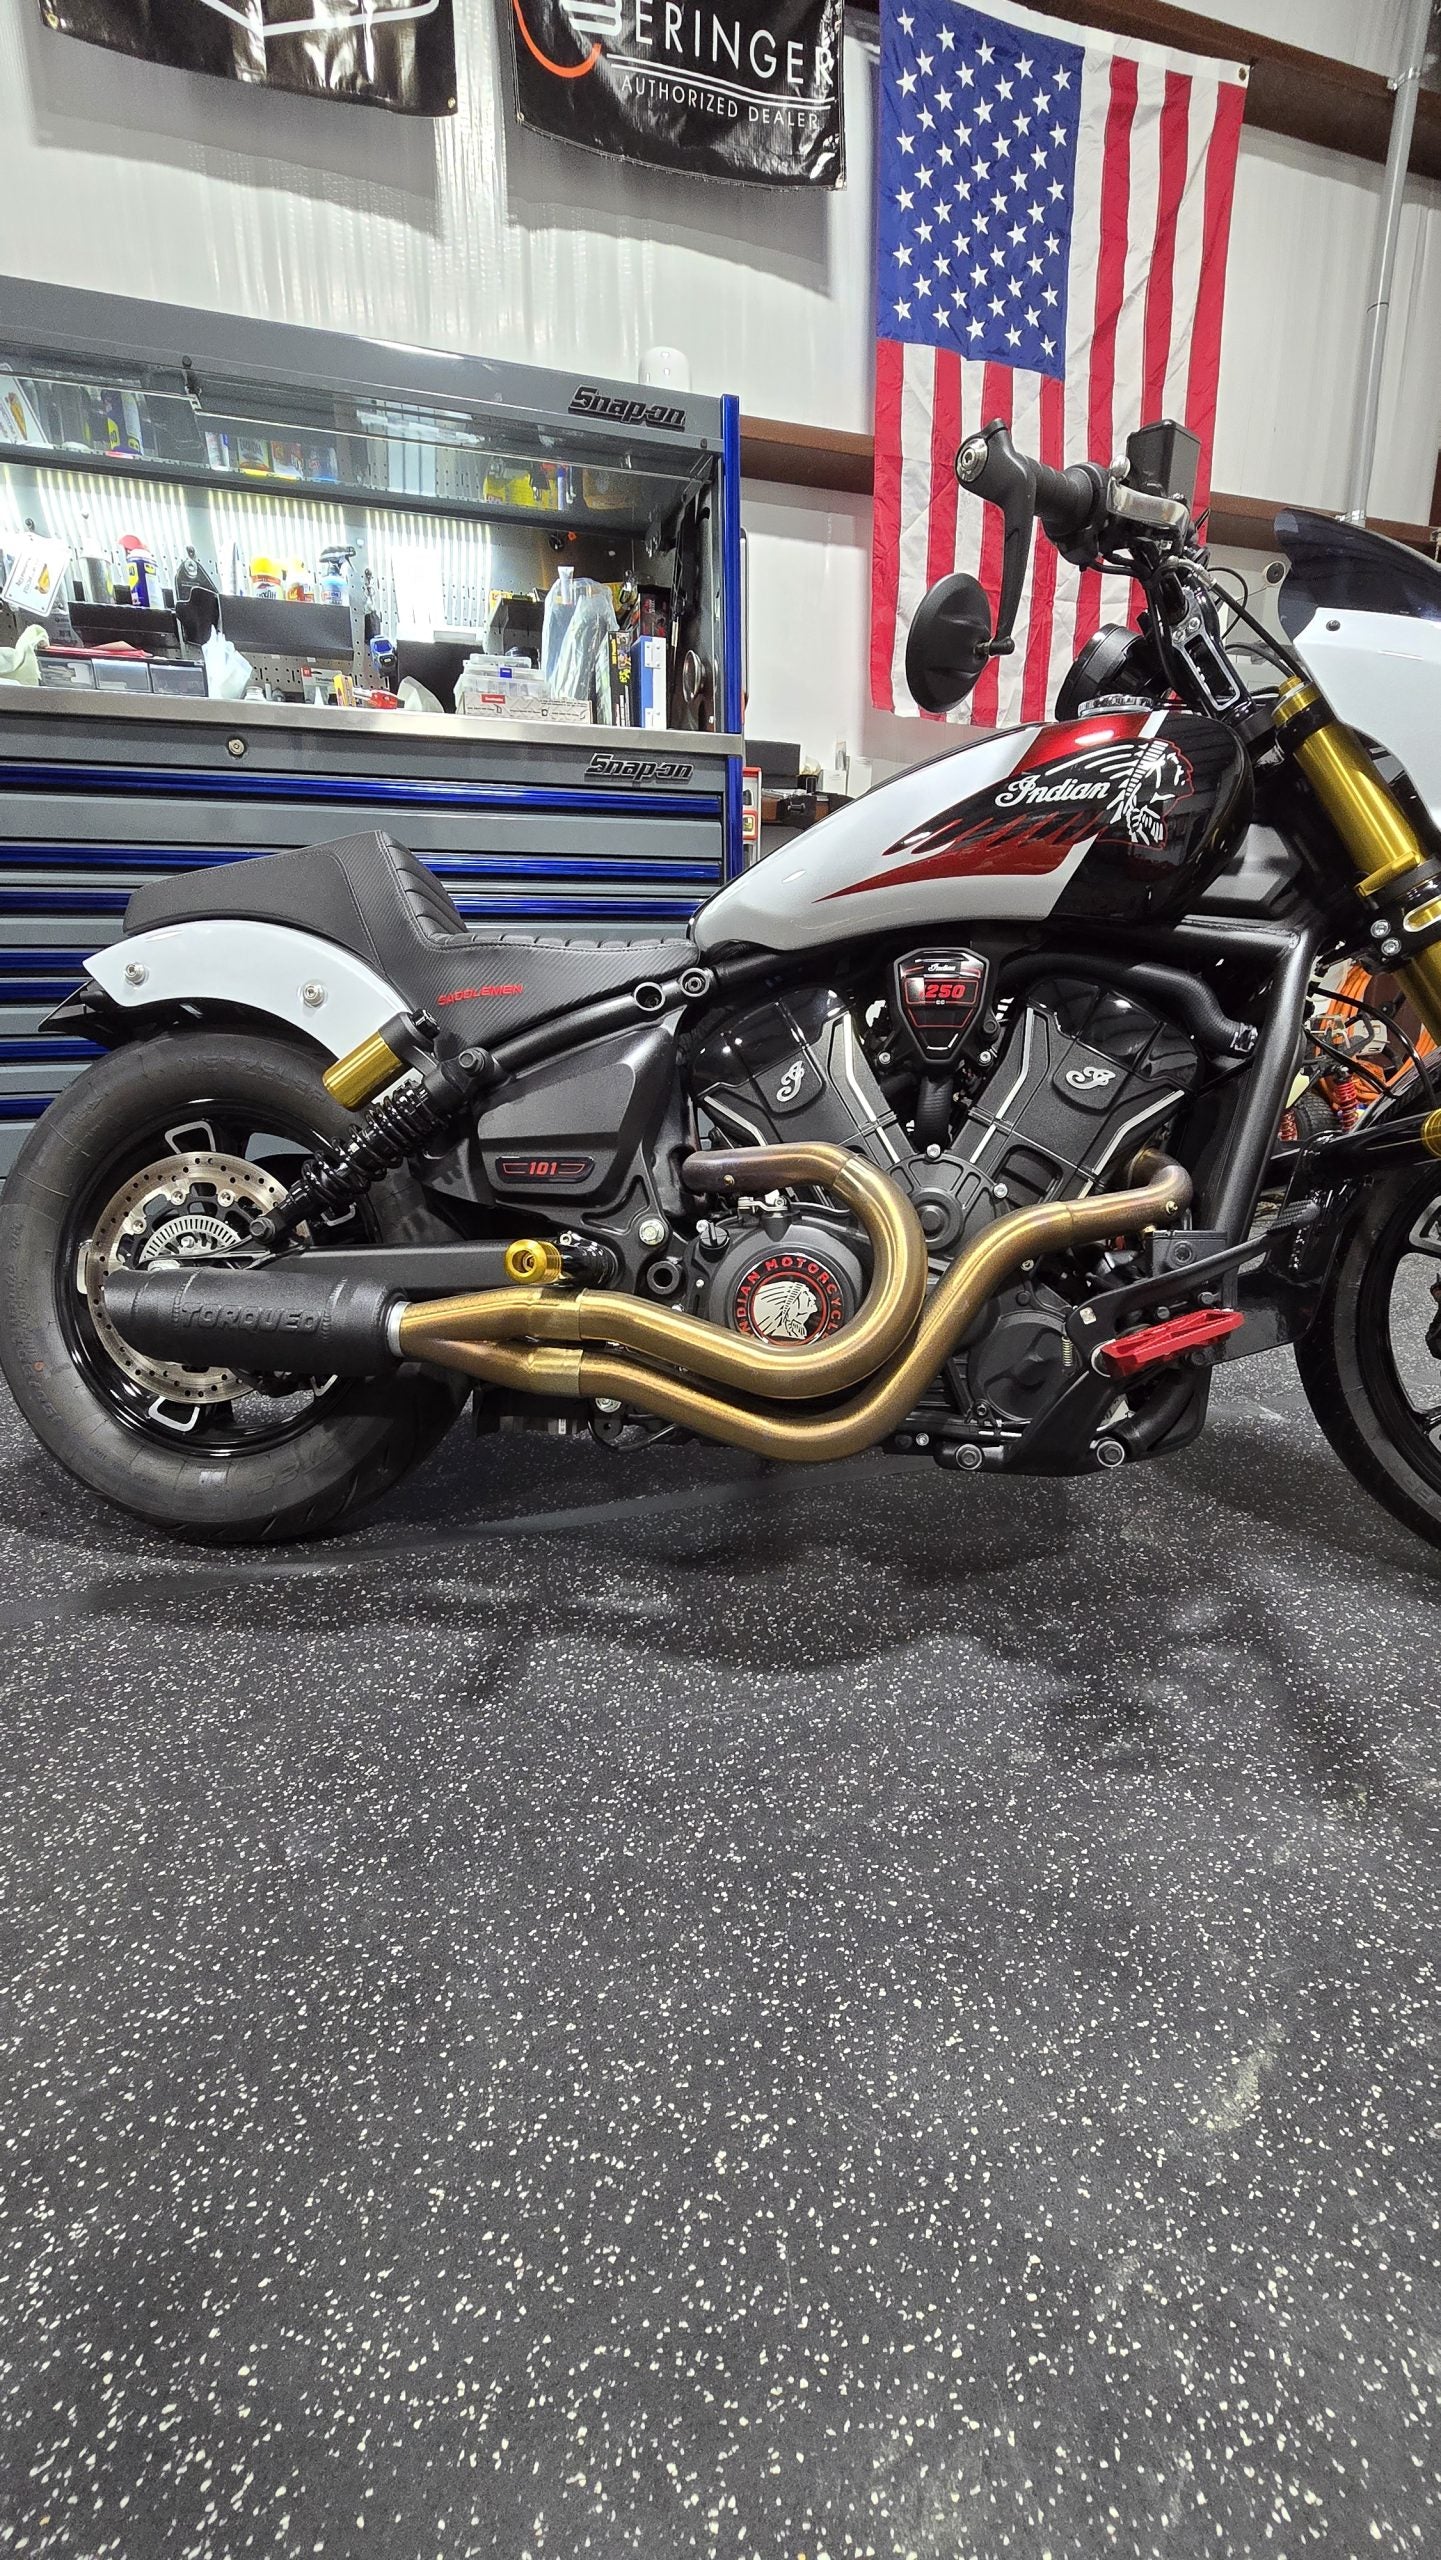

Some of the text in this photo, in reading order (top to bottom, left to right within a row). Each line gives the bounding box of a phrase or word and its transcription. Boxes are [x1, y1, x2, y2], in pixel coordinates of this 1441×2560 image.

[621, 75, 819, 128] AUTHORIZED DEALER
[569, 384, 687, 426] Snap-on
[585, 752, 694, 782] Snap-on
[994, 774, 1111, 807] Indian
[927, 962, 957, 972] Indian
[436, 983, 524, 1006] SADDLEMEN
[528, 1161, 558, 1175] 101
[736, 1270, 761, 1337] NDIAN
